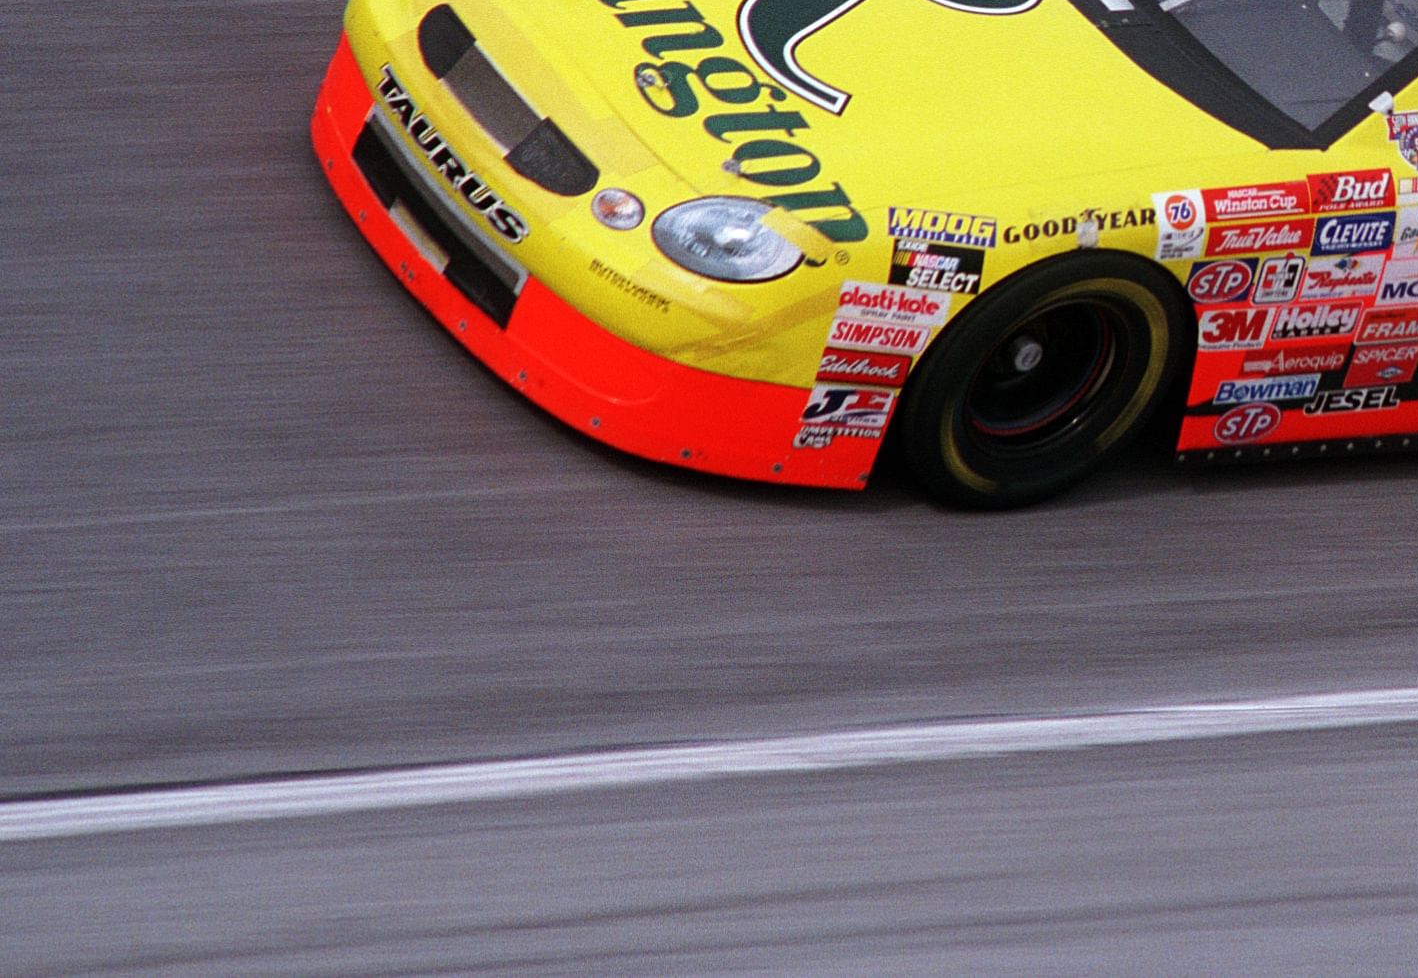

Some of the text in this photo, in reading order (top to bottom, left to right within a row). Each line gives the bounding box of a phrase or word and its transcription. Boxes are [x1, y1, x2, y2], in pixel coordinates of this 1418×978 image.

[376, 63, 530, 244] TAURUS
[1331, 172, 1389, 203] Bud
[1170, 200, 1192, 221] 76
[1214, 195, 1297, 214] Winston Cup
[1348, 200, 1384, 210] AWARD
[890, 208, 996, 238] MOOG
[1319, 218, 1389, 245] CLEVITE
[913, 253, 960, 271] NASCAR
[906, 268, 979, 294] SELECT
[1195, 265, 1242, 295] STP
[838, 286, 941, 316] plasti-kote
[1202, 309, 1268, 343] 3M
[1275, 302, 1358, 333] Holley
[831, 321, 922, 349] SIMPSON
[818, 355, 901, 380] Edelbrock
[1271, 350, 1344, 372] Aeroquip
[1353, 346, 1418, 364] SPICER
[1216, 379, 1316, 402] Bowman
[1304, 386, 1400, 415] JESEL
[802, 389, 890, 421] JE
[1222, 409, 1272, 437] STP
